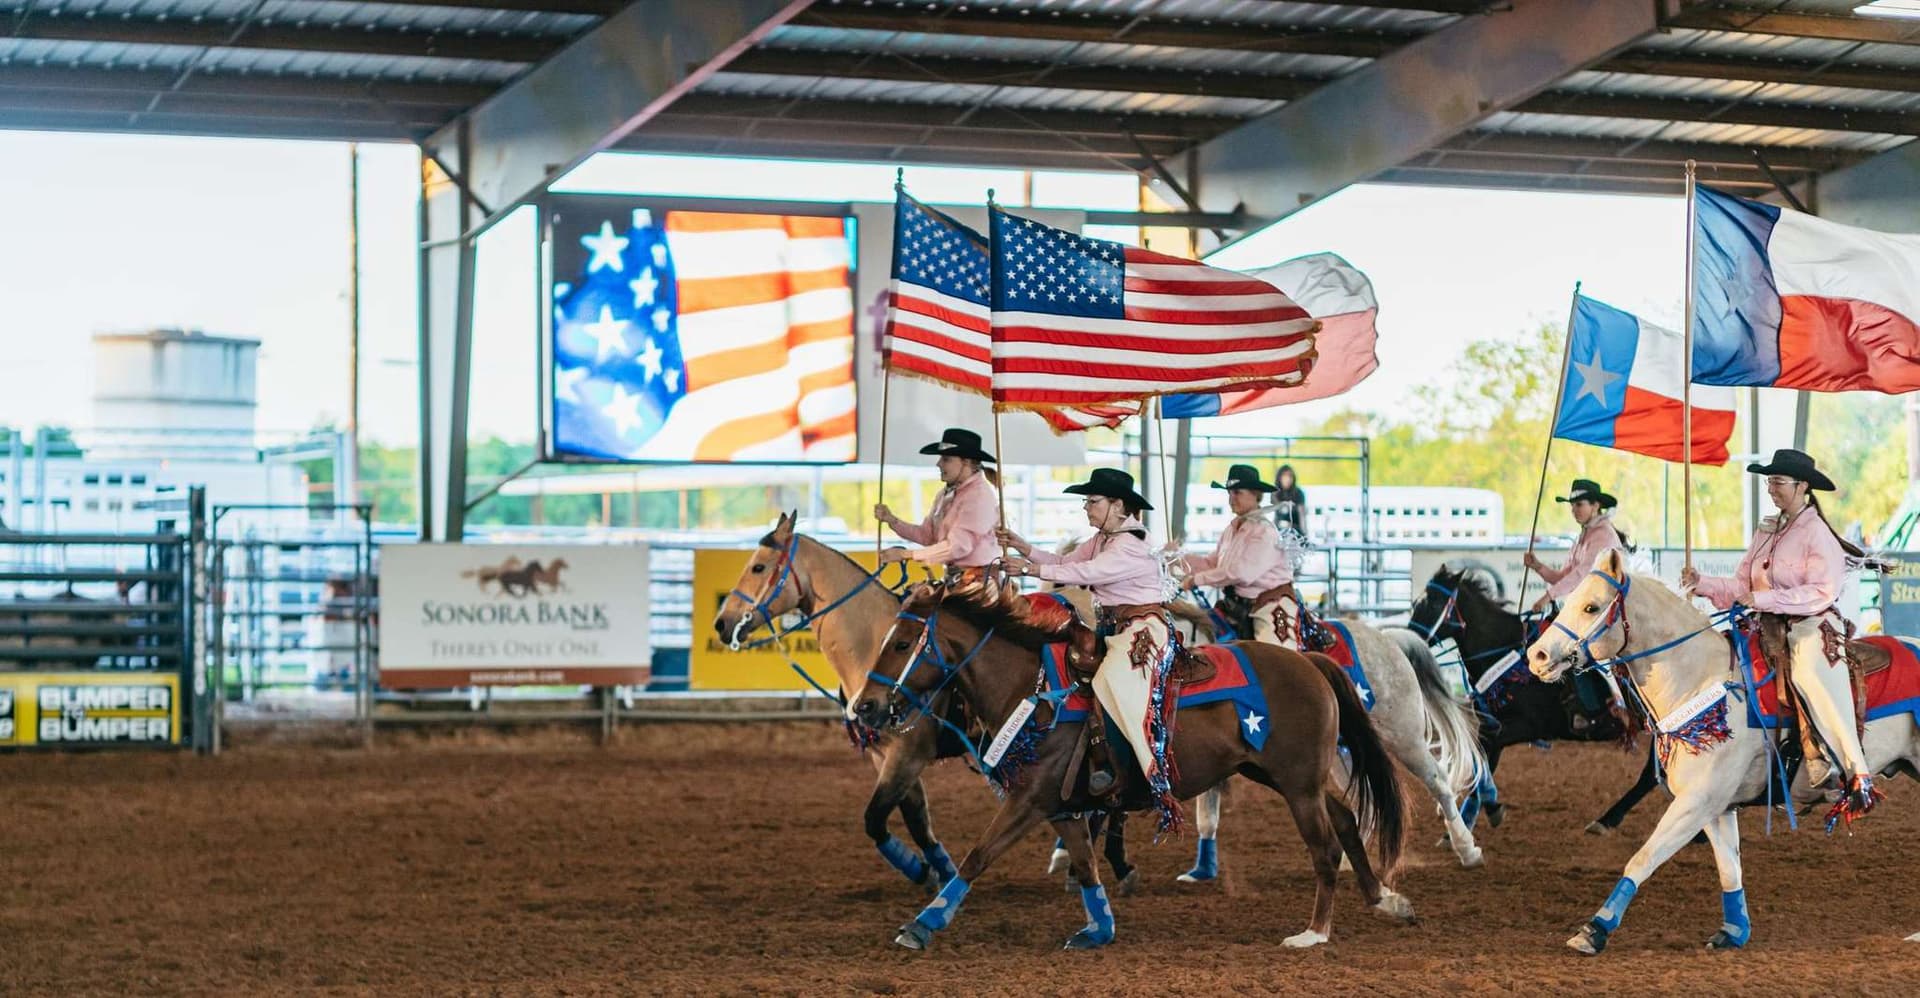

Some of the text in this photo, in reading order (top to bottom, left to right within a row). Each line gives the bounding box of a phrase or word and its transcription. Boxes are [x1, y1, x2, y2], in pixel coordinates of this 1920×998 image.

[1697, 560, 1736, 575] Origina
[421, 601, 608, 624] SONORA BANK
[503, 639, 553, 657] ONLY
[469, 671, 565, 683] sonorabank.com
[39, 686, 170, 710] BUMPER
[39, 717, 170, 741] BUMPER
